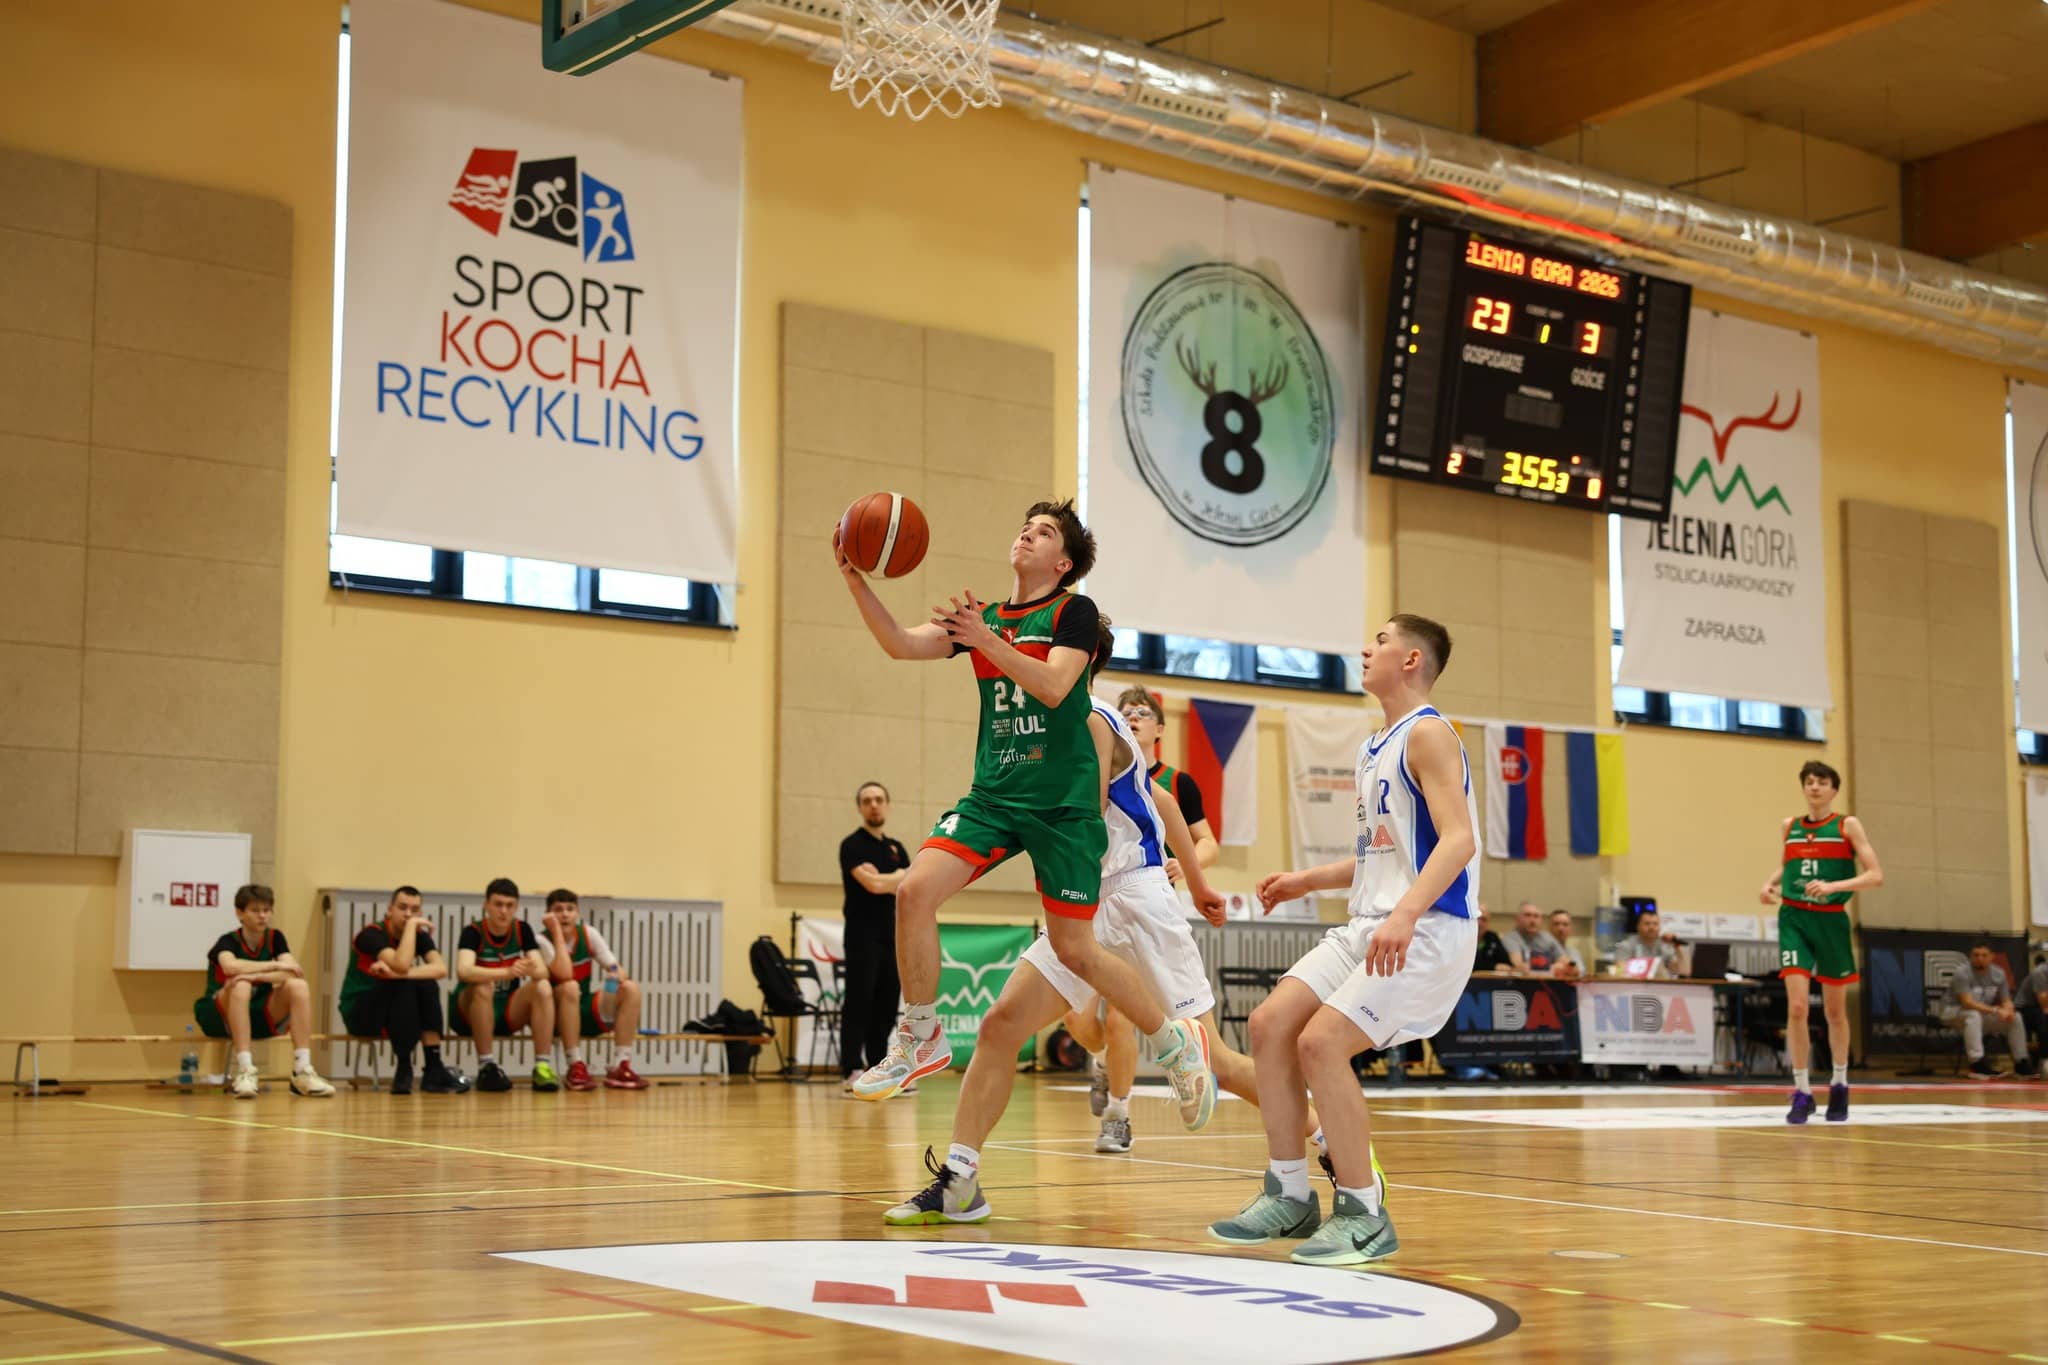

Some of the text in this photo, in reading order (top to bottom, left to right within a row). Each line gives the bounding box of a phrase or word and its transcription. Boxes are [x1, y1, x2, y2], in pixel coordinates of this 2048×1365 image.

[453, 255, 644, 335] SPORT
[1531, 257, 1574, 287] GORA
[1577, 269, 1620, 298] 2026
[1472, 297, 1511, 335] 23
[1540, 324, 1550, 344] 1
[440, 310, 650, 396] KOCHA
[1581, 322, 1601, 354] 3
[377, 361, 704, 461] RECYKLING
[1201, 390, 1265, 495] 8
[1446, 452, 1463, 474] 2
[1647, 514, 1799, 570] JELENIA GÓRA
[1654, 562, 1708, 586] STOLICA
[1684, 616, 1767, 646] ZAPRASZA
[994, 681, 1027, 712] 24
[1801, 859, 1818, 876] 21
[1061, 889, 1088, 901] PEHA
[1782, 950, 1798, 967] 21
[1456, 989, 1564, 1032] NBA
[1593, 993, 1696, 1035] NBA
[914, 1246, 1427, 1320] SUZUKI
